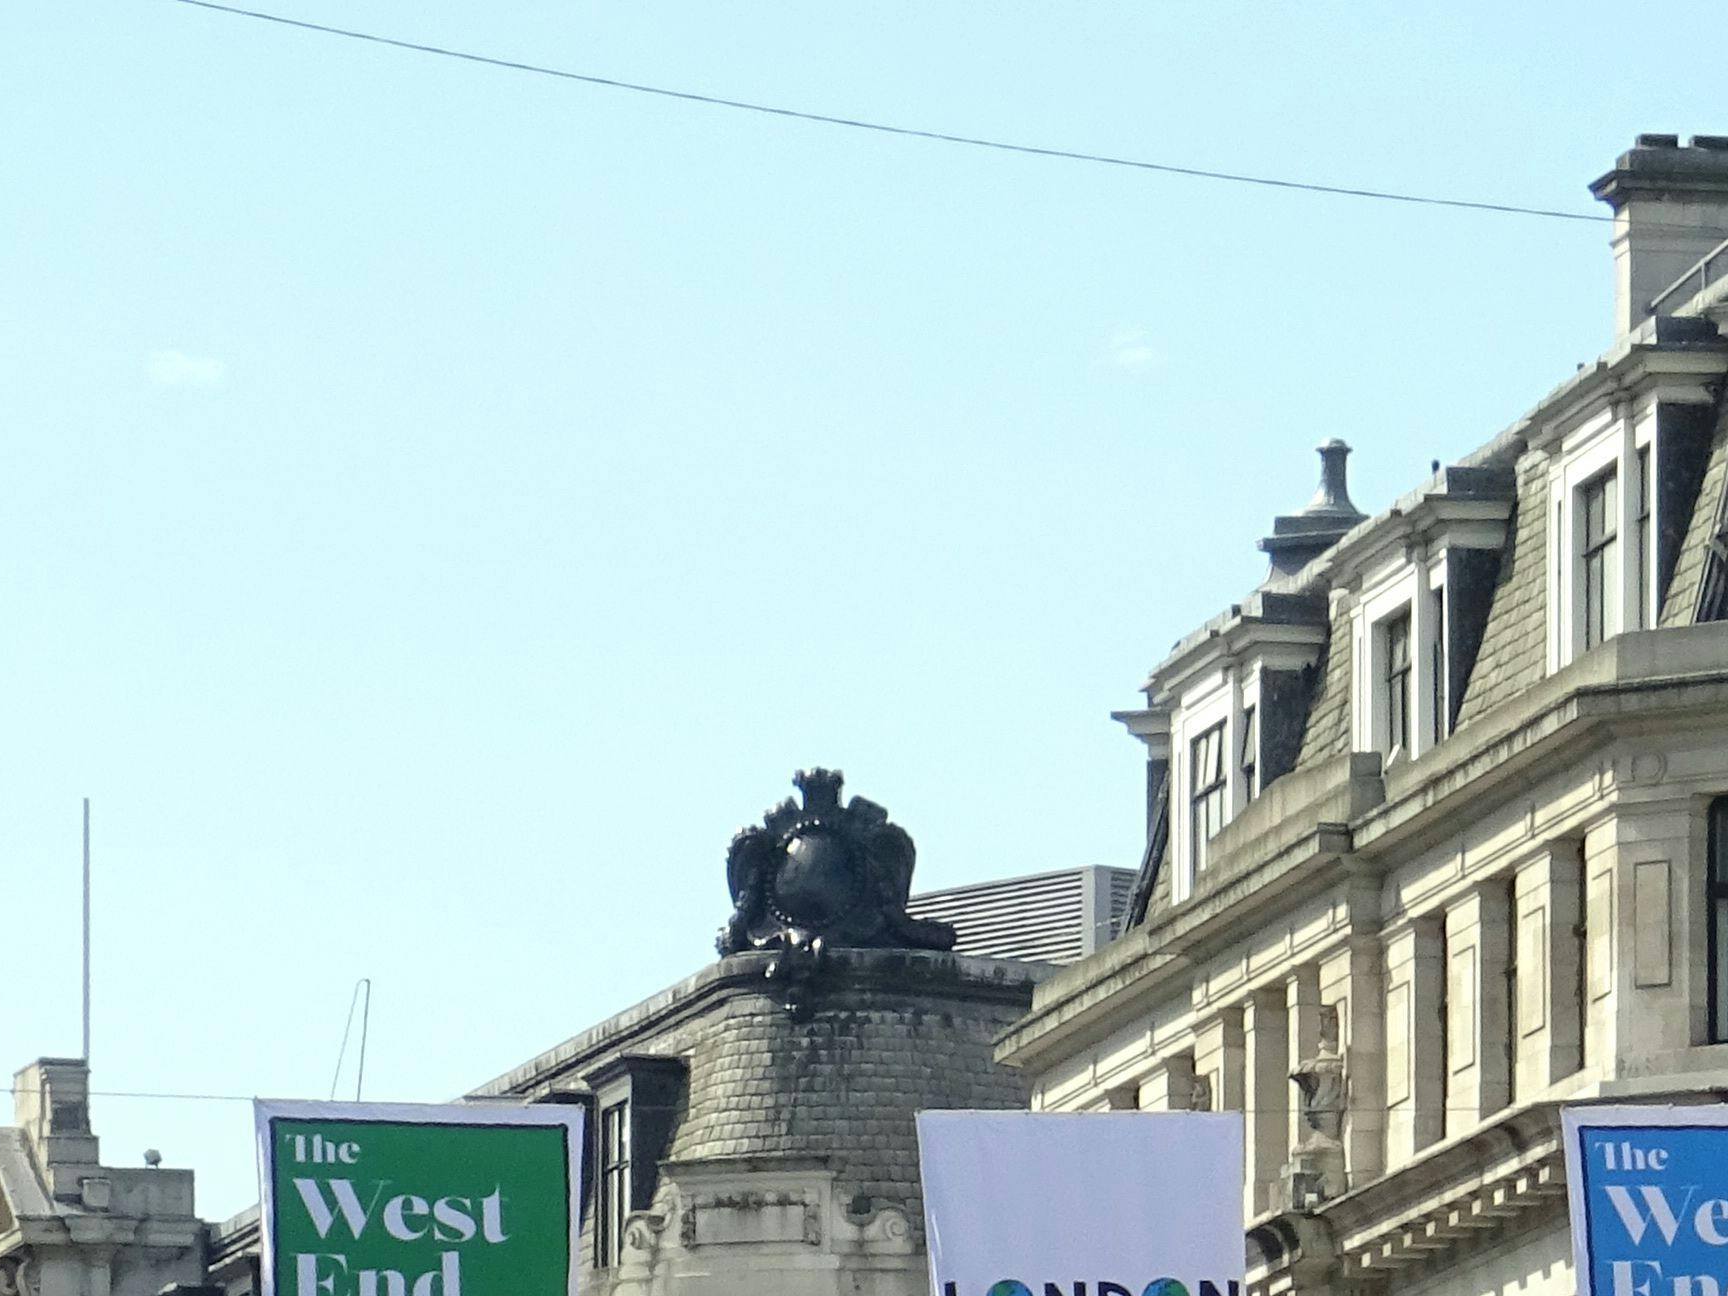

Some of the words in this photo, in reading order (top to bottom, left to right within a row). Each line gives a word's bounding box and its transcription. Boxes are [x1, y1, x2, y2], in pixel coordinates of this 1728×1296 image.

[285, 1134, 360, 1165] The
[1595, 1141, 1668, 1171] The
[293, 1178, 509, 1244] West
